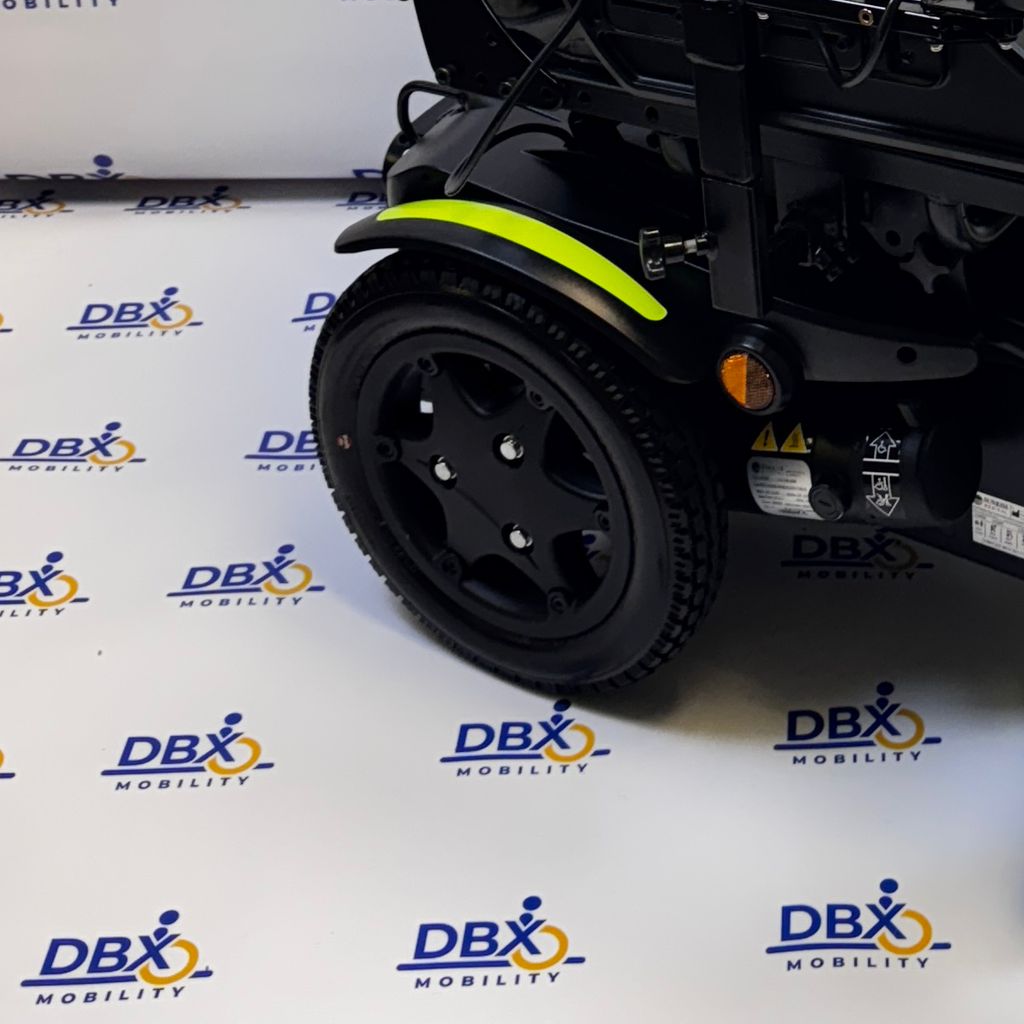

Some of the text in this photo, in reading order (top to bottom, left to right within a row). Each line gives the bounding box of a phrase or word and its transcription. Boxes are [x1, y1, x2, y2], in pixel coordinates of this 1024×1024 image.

[79, 300, 179, 325] DBX
[77, 330, 183, 340] MOBILITY
[12, 436, 121, 458] DBX
[258, 431, 318, 453] DB
[8, 465, 125, 473] MOBILITY
[0, 569, 64, 597] BX
[181, 559, 297, 590] DBX
[0, 607, 65, 617] ILITY
[179, 596, 303, 608] MOBILITY
[786, 703, 901, 743] DBX
[455, 716, 576, 754] DBX
[118, 732, 244, 766] DBX
[792, 750, 922, 765] MOBILITY
[457, 763, 588, 777] MOBILITY
[115, 776, 249, 791] MOBILITY
[780, 901, 905, 941] DBX
[413, 918, 545, 962] DBX
[40, 935, 179, 975] DBX
[787, 956, 929, 971] MOBILITY
[415, 972, 561, 989] MOBILITY
[35, 987, 186, 1006] MOBILITY
